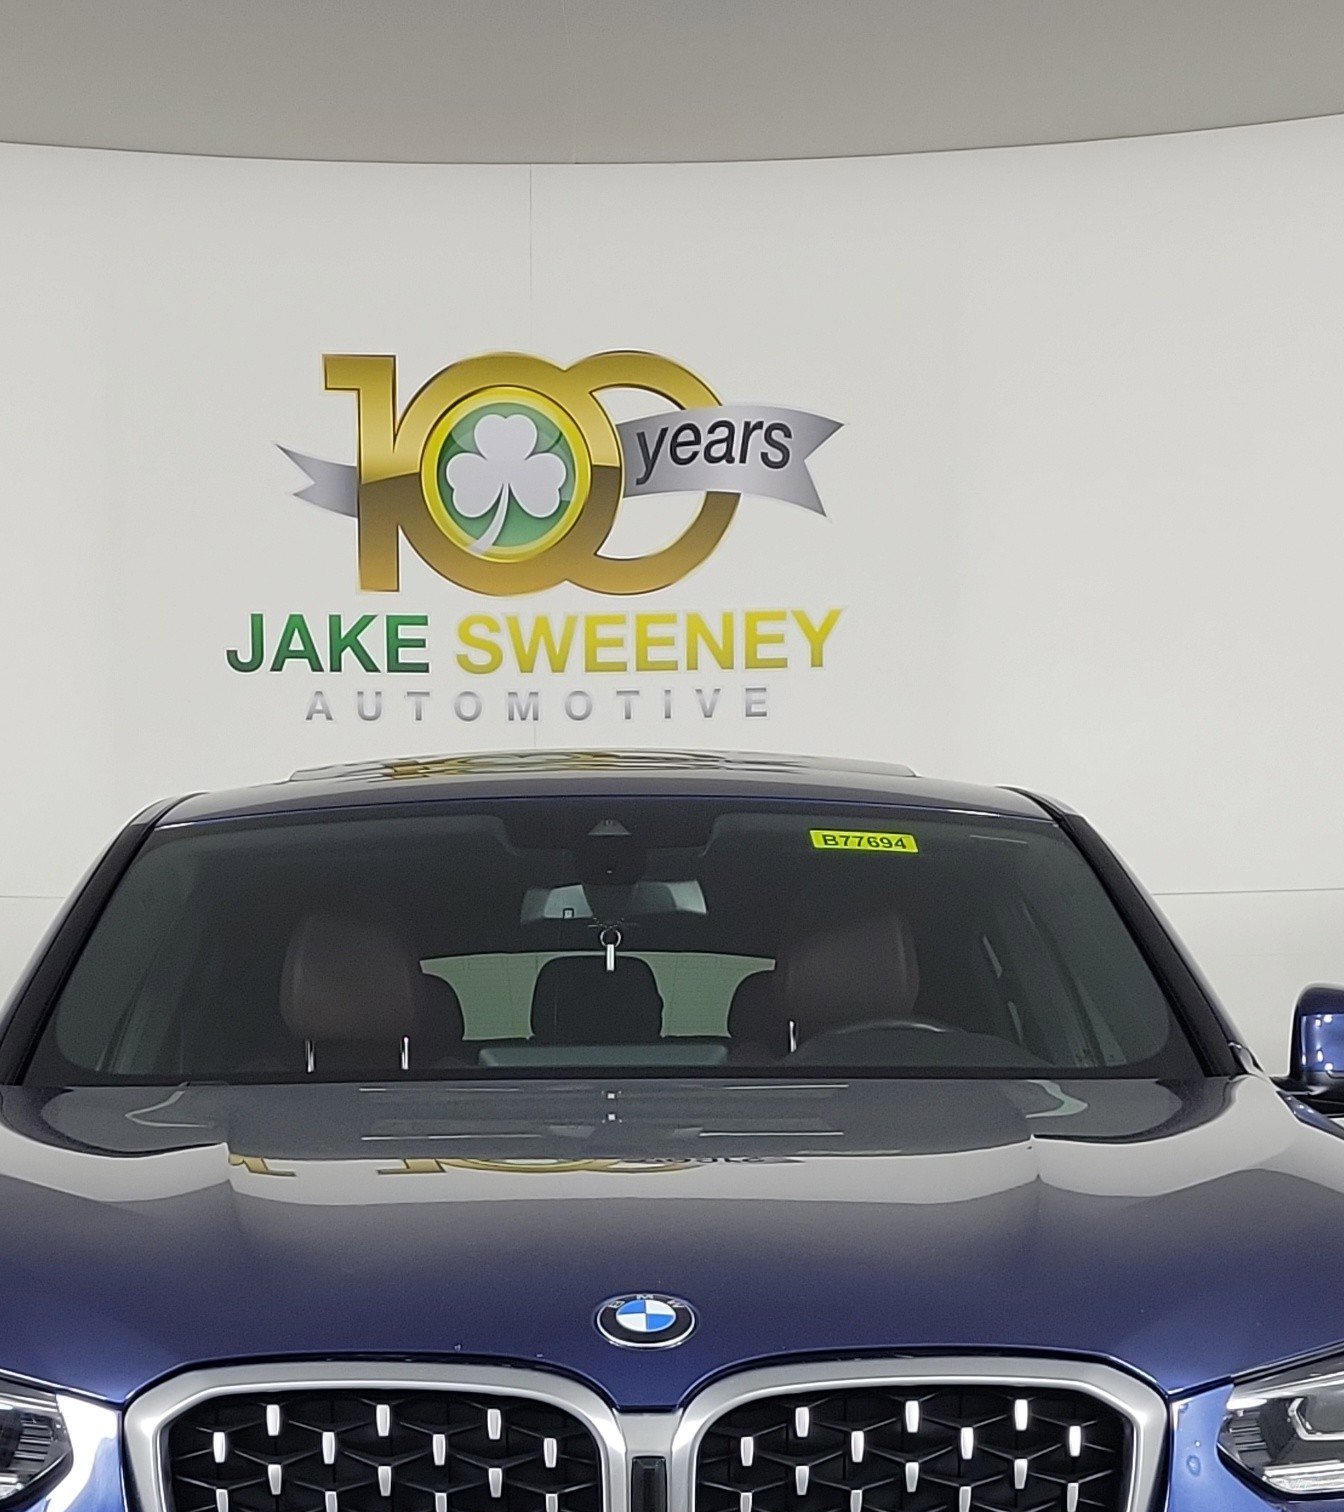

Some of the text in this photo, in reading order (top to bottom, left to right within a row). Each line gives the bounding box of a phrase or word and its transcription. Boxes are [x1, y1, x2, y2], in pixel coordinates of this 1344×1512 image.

[321, 348, 793, 597] 100 years
[226, 609, 843, 674] JAKE SWEENEY
[305, 687, 768, 722] AUTOMOTIVE
[822, 834, 906, 850] B77694
